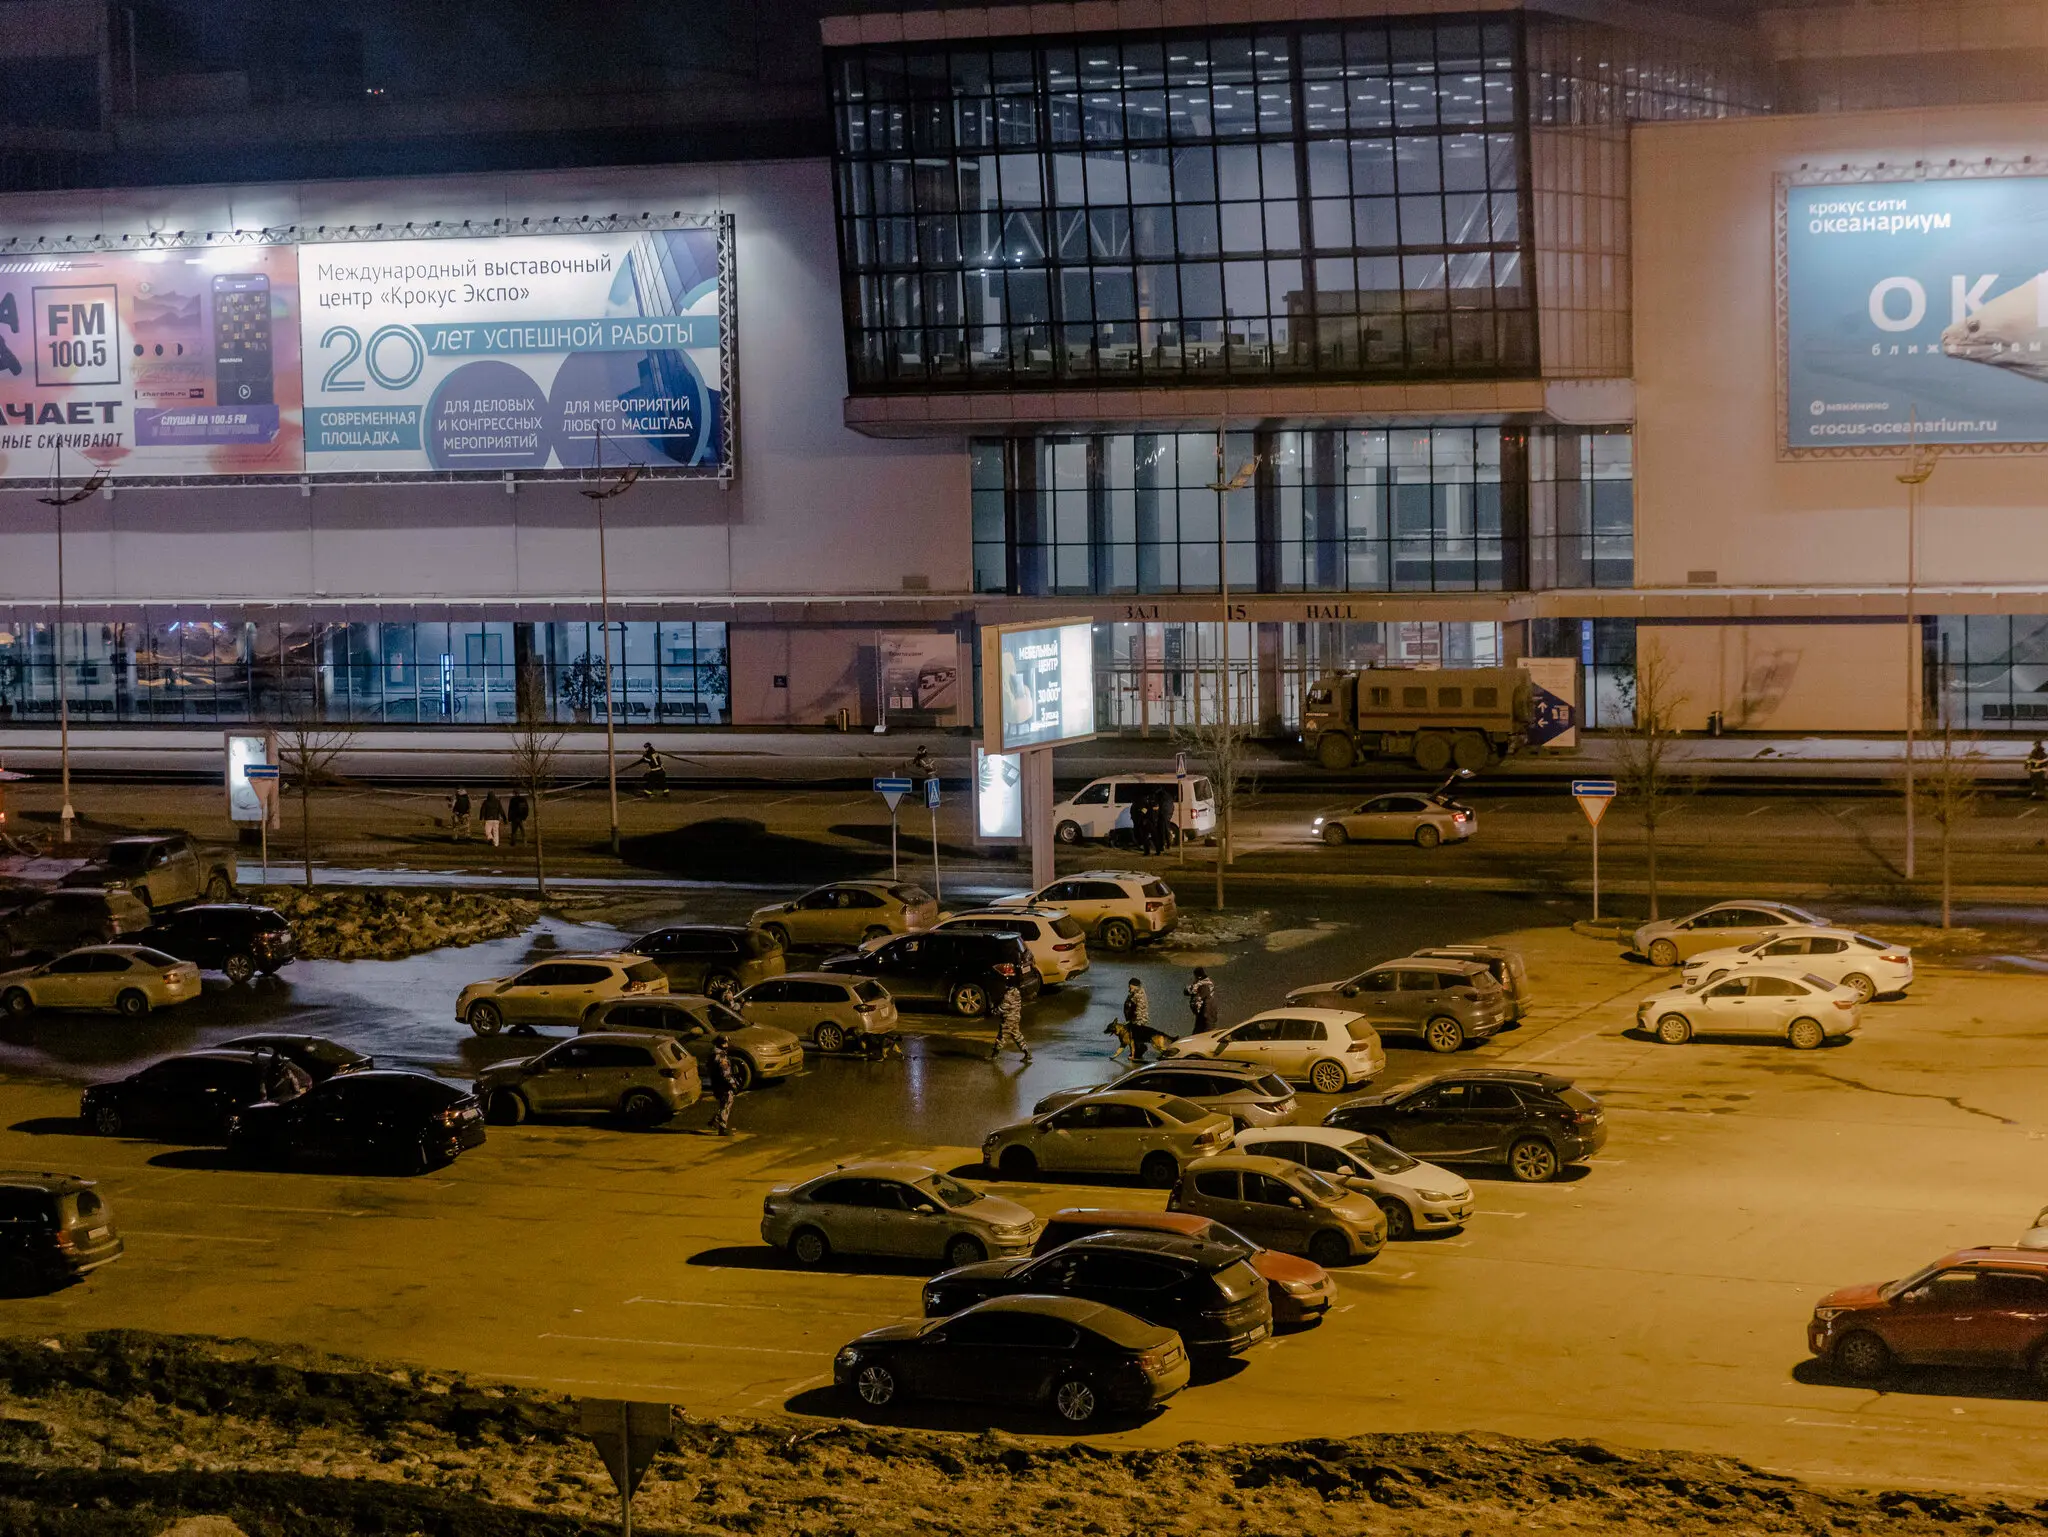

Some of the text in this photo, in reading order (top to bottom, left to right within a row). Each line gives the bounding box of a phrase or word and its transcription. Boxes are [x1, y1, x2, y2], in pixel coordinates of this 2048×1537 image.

[1809, 198, 1907, 217] крокус сити
[1809, 212, 1952, 235] океанариум
[318, 253, 611, 285] Международный выставочный
[319, 283, 530, 310] центр «Крокус Экспо»
[1869, 270, 2048, 332] ОК
[48, 303, 106, 337] FM
[432, 322, 694, 350] лет УСПЕШНОЙ РАБОТЫ
[48, 340, 107, 368] 100.5
[320, 323, 424, 392] 20
[0, 401, 123, 426] ЧАЕТ
[444, 398, 535, 414] ДЛЯ ДЕЛОВЫХ
[564, 395, 690, 415] ДЛЯ МЕРОПРИЯТИЙ
[160, 414, 248, 426] СЛУШАЙ НА 100.5 FM
[320, 411, 416, 427] СОВРЕМЕННАЯ
[438, 416, 543, 432] И КОНГРЕССНЫХ
[562, 416, 693, 432] ЛЮБОГО МАСШТАБА
[1809, 417, 1998, 436] crocus-oceanarium.ru
[0, 432, 124, 450] НЫЕ СКАЧИВАЮТ
[321, 430, 400, 447] ПЛОЩАДКА
[443, 432, 538, 450] МЕРОПРИЯТИЙ
[1124, 604, 1358, 621] ЗАЛ 15 HALL
[1018, 639, 1059, 661] МЕБЕЛЬНЫЙ
[1038, 657, 1059, 675] ЦЕНТР
